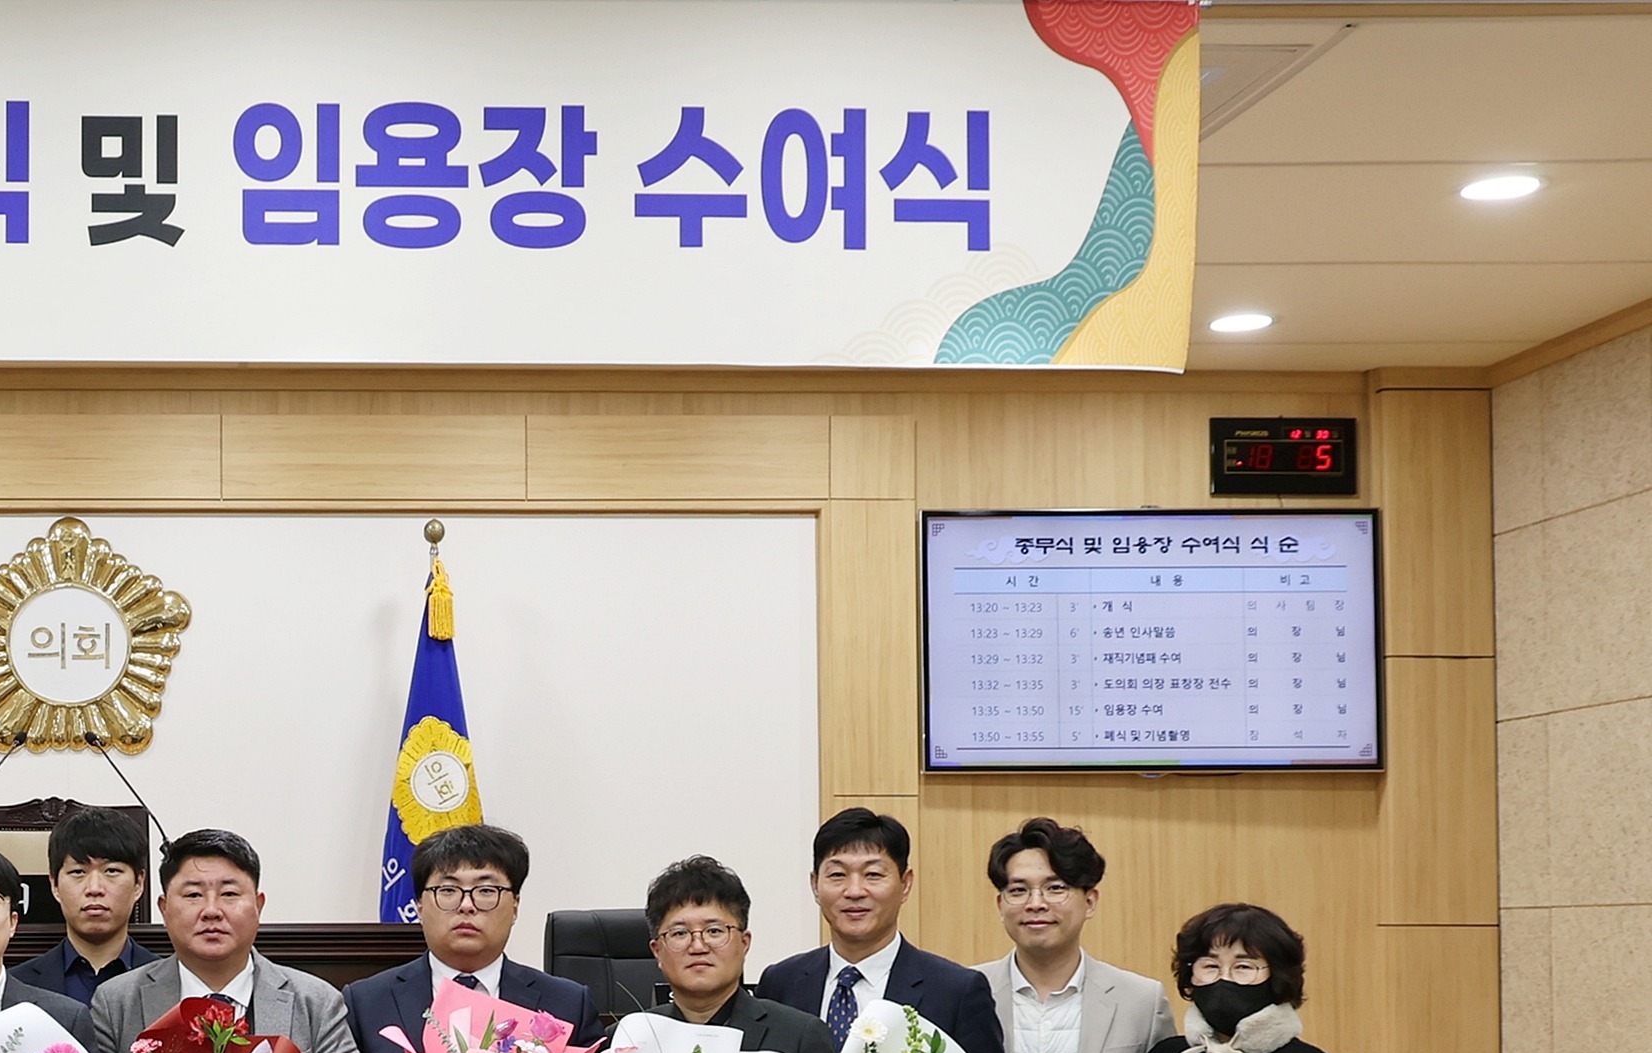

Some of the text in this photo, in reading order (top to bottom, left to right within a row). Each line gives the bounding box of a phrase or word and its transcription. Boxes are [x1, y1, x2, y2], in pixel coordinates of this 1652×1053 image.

[82, 115, 184, 246] 및
[234, 103, 597, 248] 임용장
[635, 108, 989, 250] 수여식
[1015, 536, 1299, 554] 종무식 및 임용장 수여식 식 순
[970, 602, 998, 613] 13:20
[1014, 602, 1042, 613] 13:23
[971, 628, 998, 639] 13:23
[1015, 628, 1043, 639] 13:29
[28, 622, 110, 670] 의회
[971, 654, 999, 665] 13:29
[1016, 654, 1043, 665] 13:32
[971, 680, 999, 690] 13:32
[1016, 680, 1044, 690] 13:35
[972, 706, 1000, 716] 13:35
[1016, 706, 1044, 716] 13:50
[972, 731, 1000, 742] 13:50
[1017, 731, 1044, 742] 13:55
[424, 761, 460, 806] 의회
